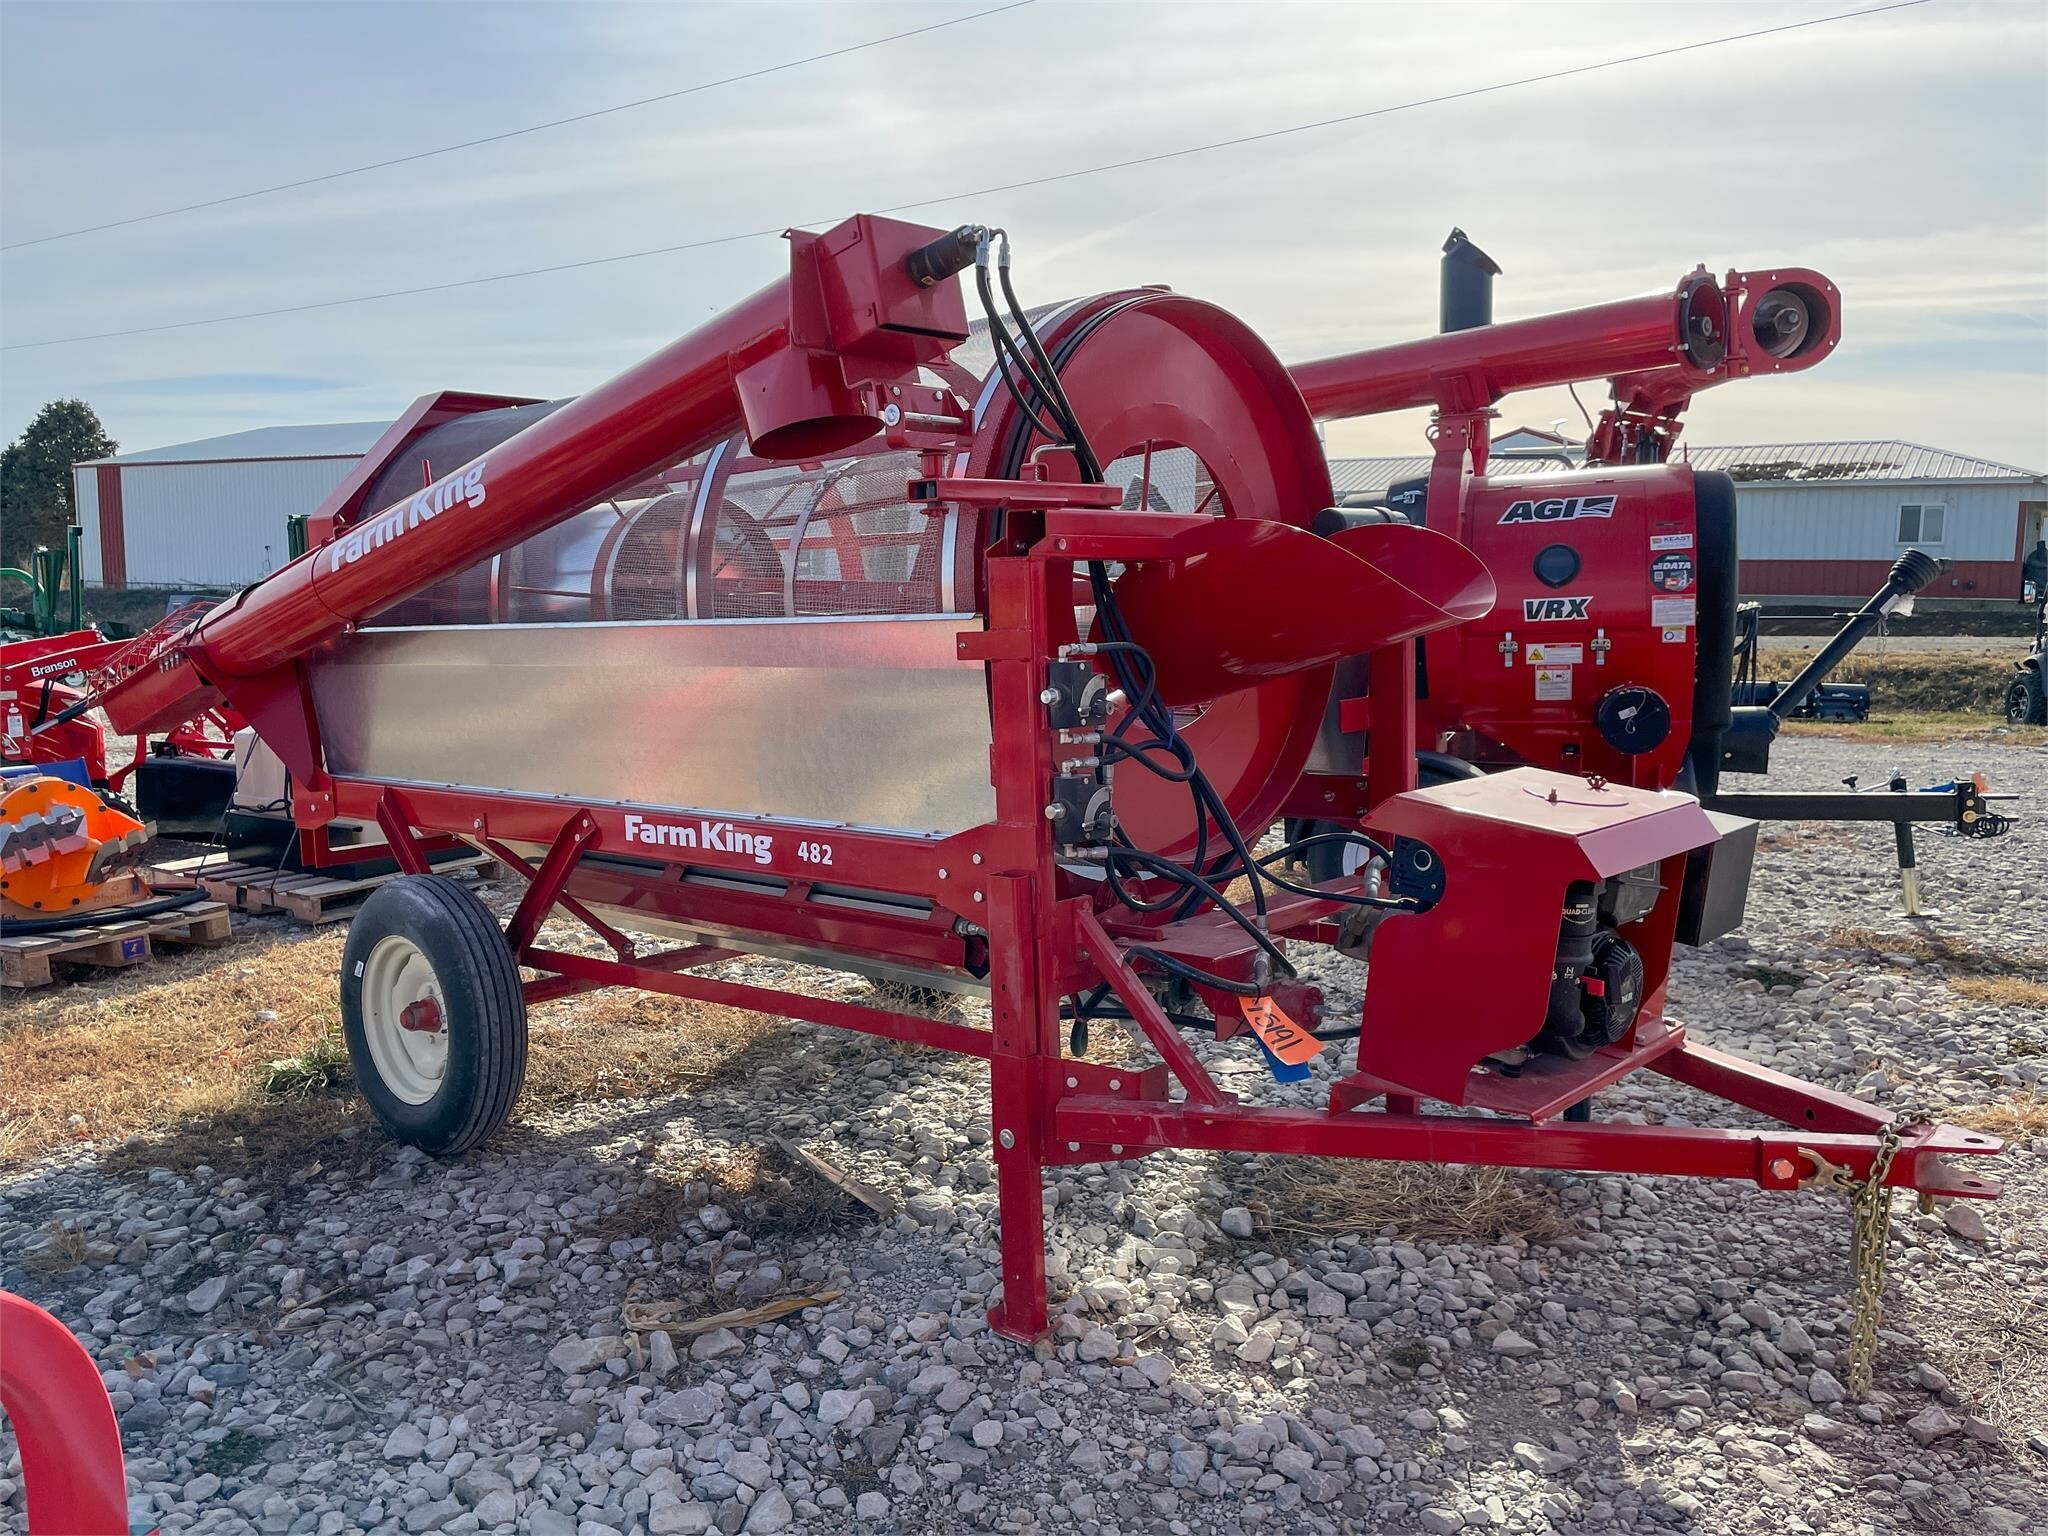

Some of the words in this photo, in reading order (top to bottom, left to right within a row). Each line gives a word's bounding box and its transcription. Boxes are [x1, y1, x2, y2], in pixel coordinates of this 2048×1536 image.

[331, 511, 405, 573] Farm
[409, 461, 487, 509] King
[1499, 498, 1578, 523] AGI
[1525, 598, 1589, 620] VRX
[31, 658, 77, 677] Branson
[624, 814, 697, 848] Farm
[700, 821, 773, 865] King
[797, 841, 833, 866] 482
